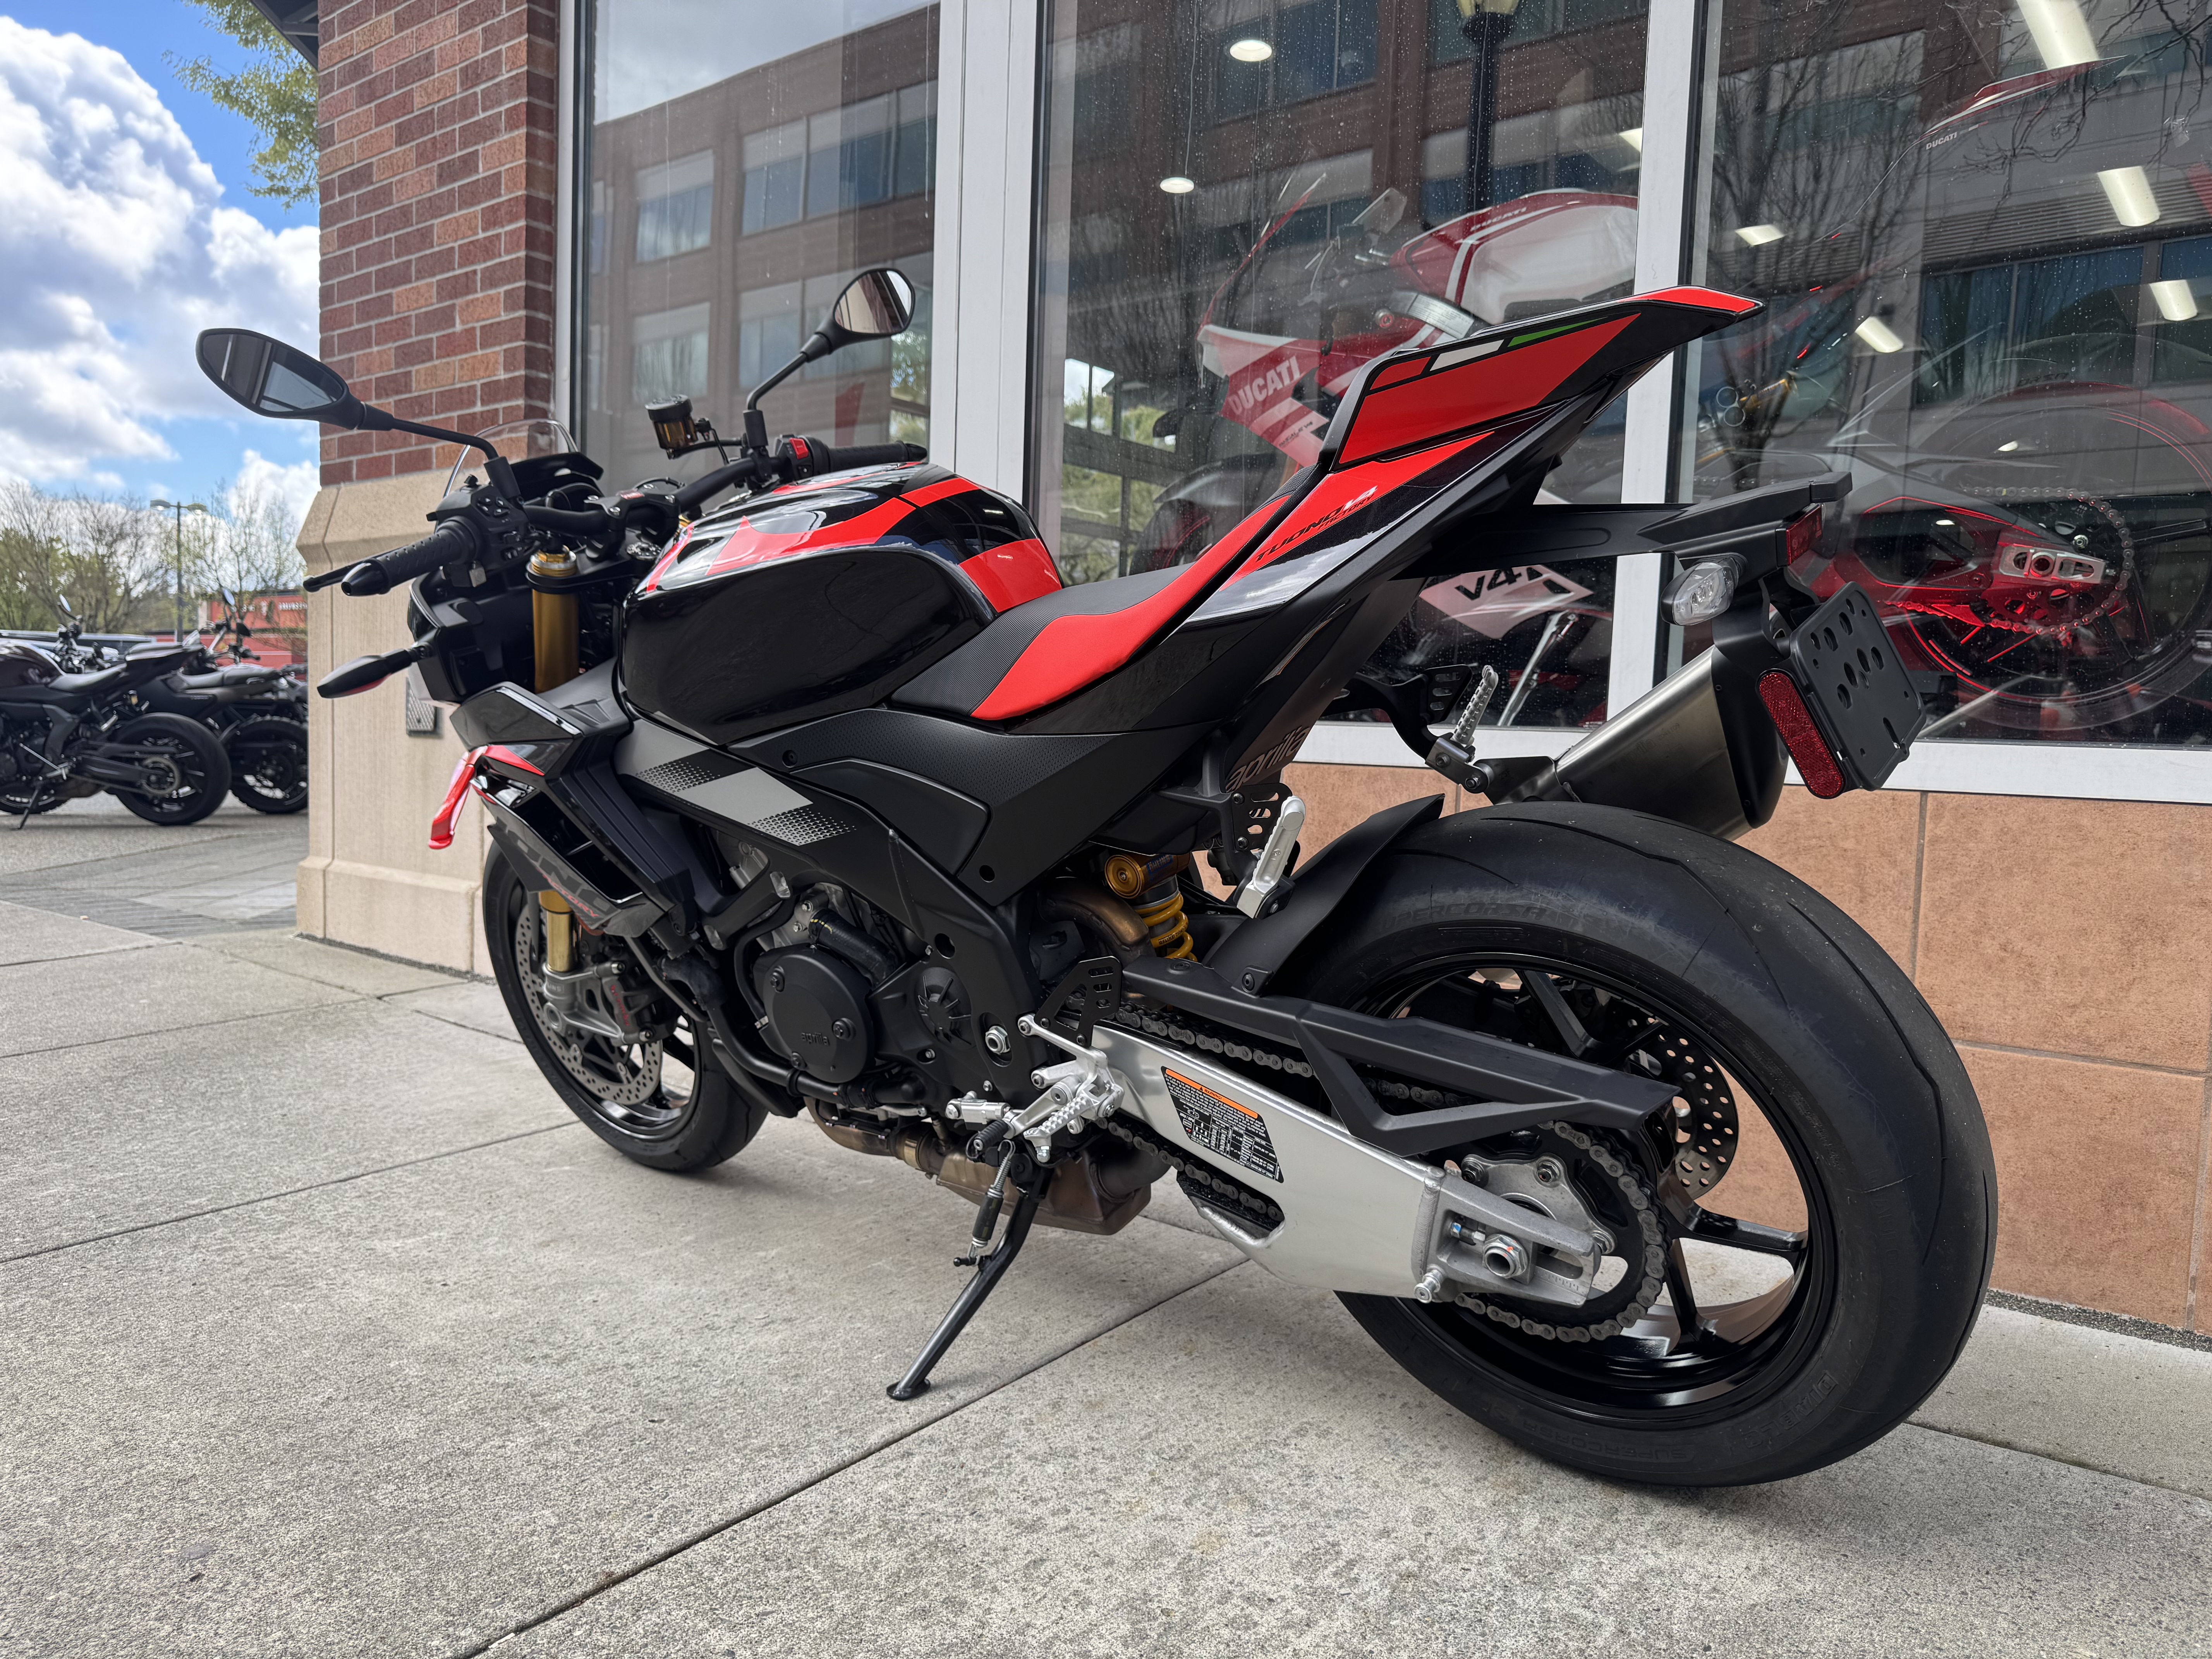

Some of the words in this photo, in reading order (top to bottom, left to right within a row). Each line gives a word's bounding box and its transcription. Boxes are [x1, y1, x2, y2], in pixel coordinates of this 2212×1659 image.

[1926, 132, 1957, 149] DUCATI
[1227, 356, 1301, 414] DUCATI
[1255, 505, 1346, 562] TUONO
[1343, 485, 1378, 511] V4
[1317, 493, 1374, 531] FACTORY
[1455, 568, 1522, 601] V4
[1225, 725, 1312, 793] aprilia
[801, 1032, 830, 1046] aprilia
